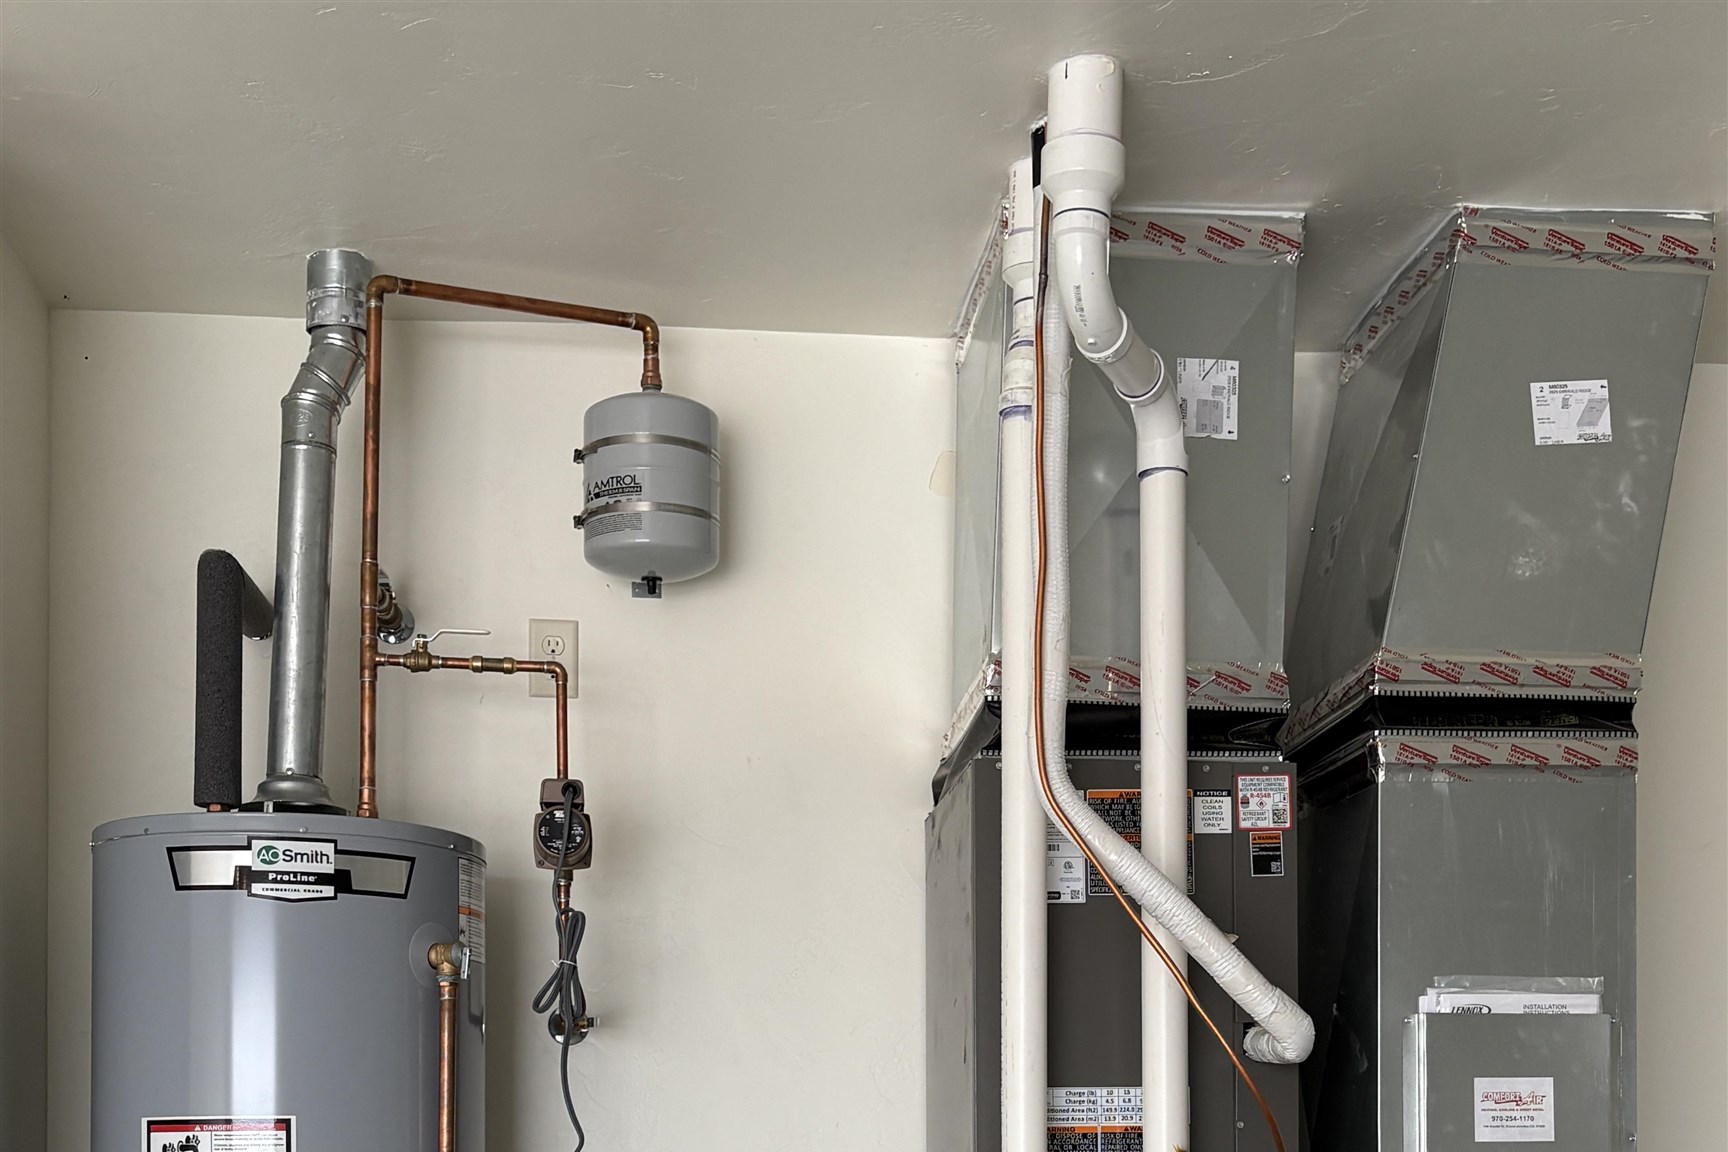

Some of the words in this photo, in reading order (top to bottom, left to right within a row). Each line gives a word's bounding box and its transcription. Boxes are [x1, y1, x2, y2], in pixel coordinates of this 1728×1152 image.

[593, 474, 641, 492] AMTROL
[268, 872, 315, 882] ProLine
[1452, 1006, 1484, 1014] LENNOX
[1482, 1092, 1521, 1102] COMFORT
